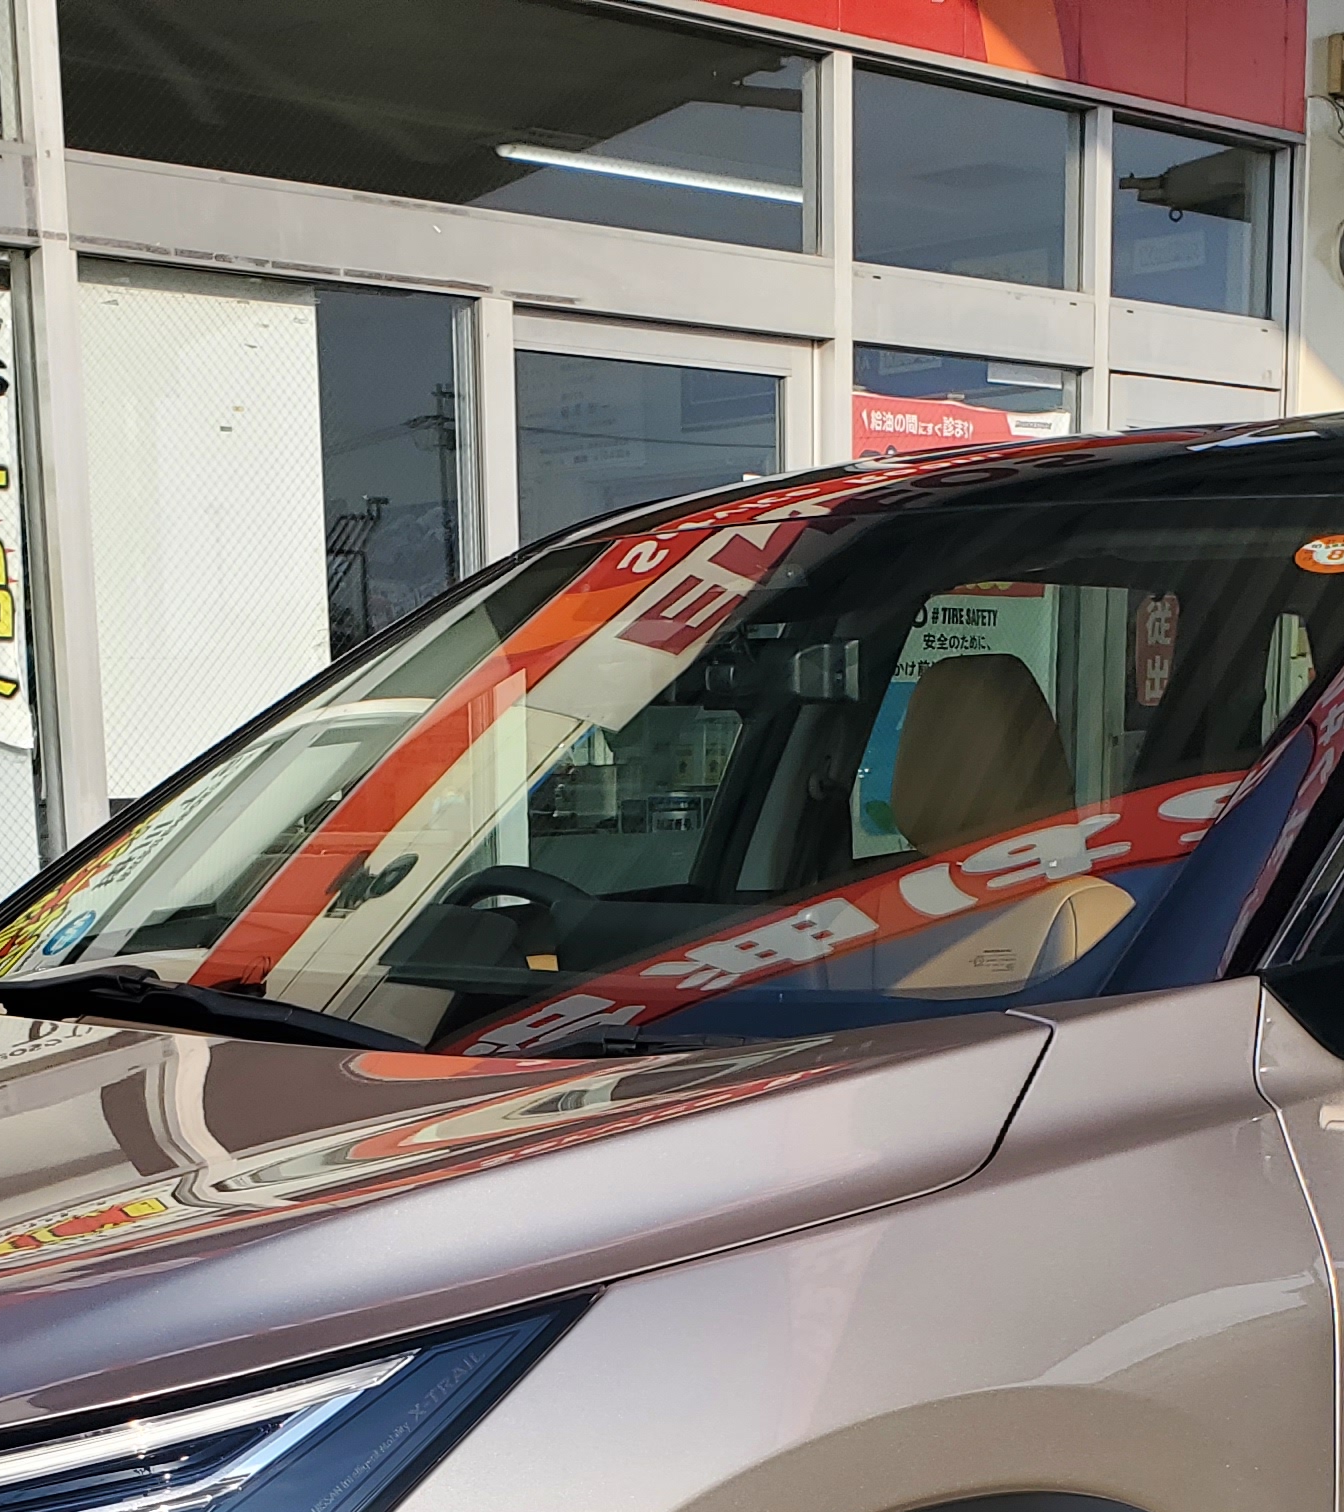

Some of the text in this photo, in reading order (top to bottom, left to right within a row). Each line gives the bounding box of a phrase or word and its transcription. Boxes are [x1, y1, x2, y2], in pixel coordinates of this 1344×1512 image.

[941, 607, 964, 626] TIRE
[966, 608, 998, 628] SAFETY
[922, 632, 992, 652] 安全のために、
